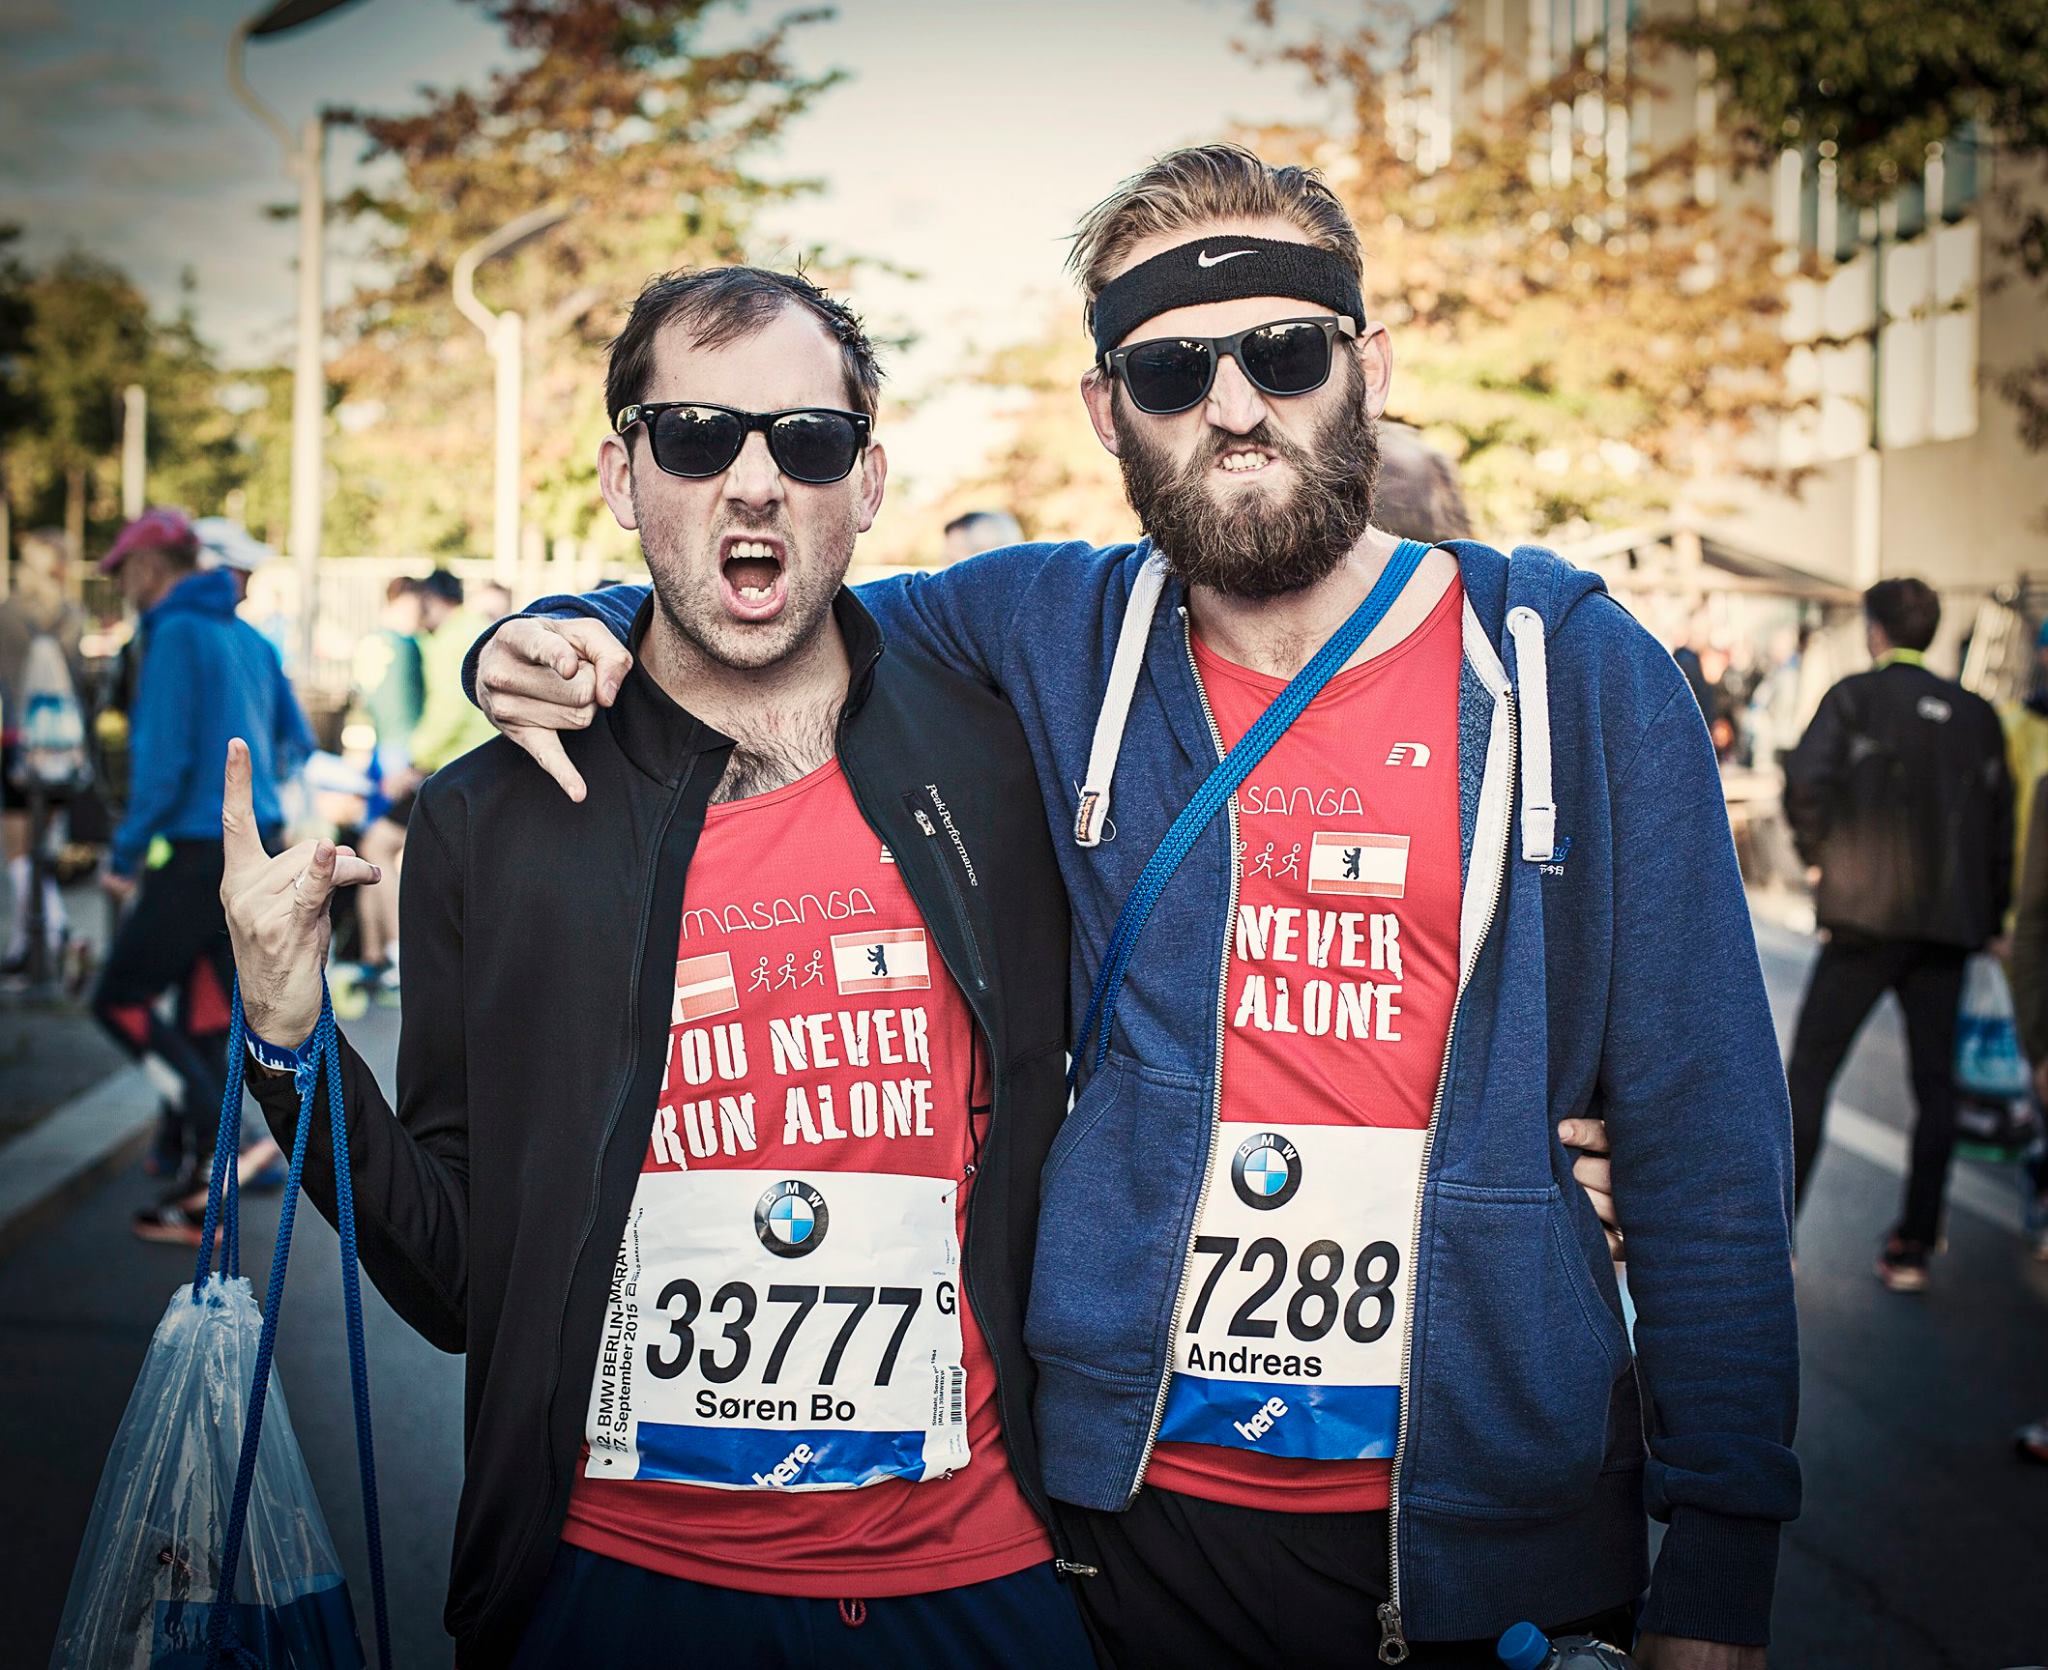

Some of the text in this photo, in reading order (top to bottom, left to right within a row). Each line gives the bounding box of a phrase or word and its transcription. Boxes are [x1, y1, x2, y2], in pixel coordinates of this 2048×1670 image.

[1239, 786, 1364, 816] SANGA
[682, 887, 876, 940] MASANGA
[1236, 904, 1404, 980] NEVER
[1234, 975, 1402, 1041] ALONE
[769, 1007, 932, 1075] NEVER
[651, 1077, 934, 1171] RUN ALONE
[1239, 1134, 1297, 1160] BMW
[762, 1181, 823, 1208] BMW
[602, 1207, 631, 1376] BERLIN-MARA
[645, 1278, 956, 1387] 33777 G
[614, 1344, 633, 1433] September
[624, 1303, 639, 1342] 2015
[1187, 1343, 1323, 1378] Andreas
[598, 1380, 615, 1427] BMW
[695, 1389, 856, 1421] Søren Bo
[1233, 1396, 1289, 1442] here
[751, 1443, 815, 1487] here
